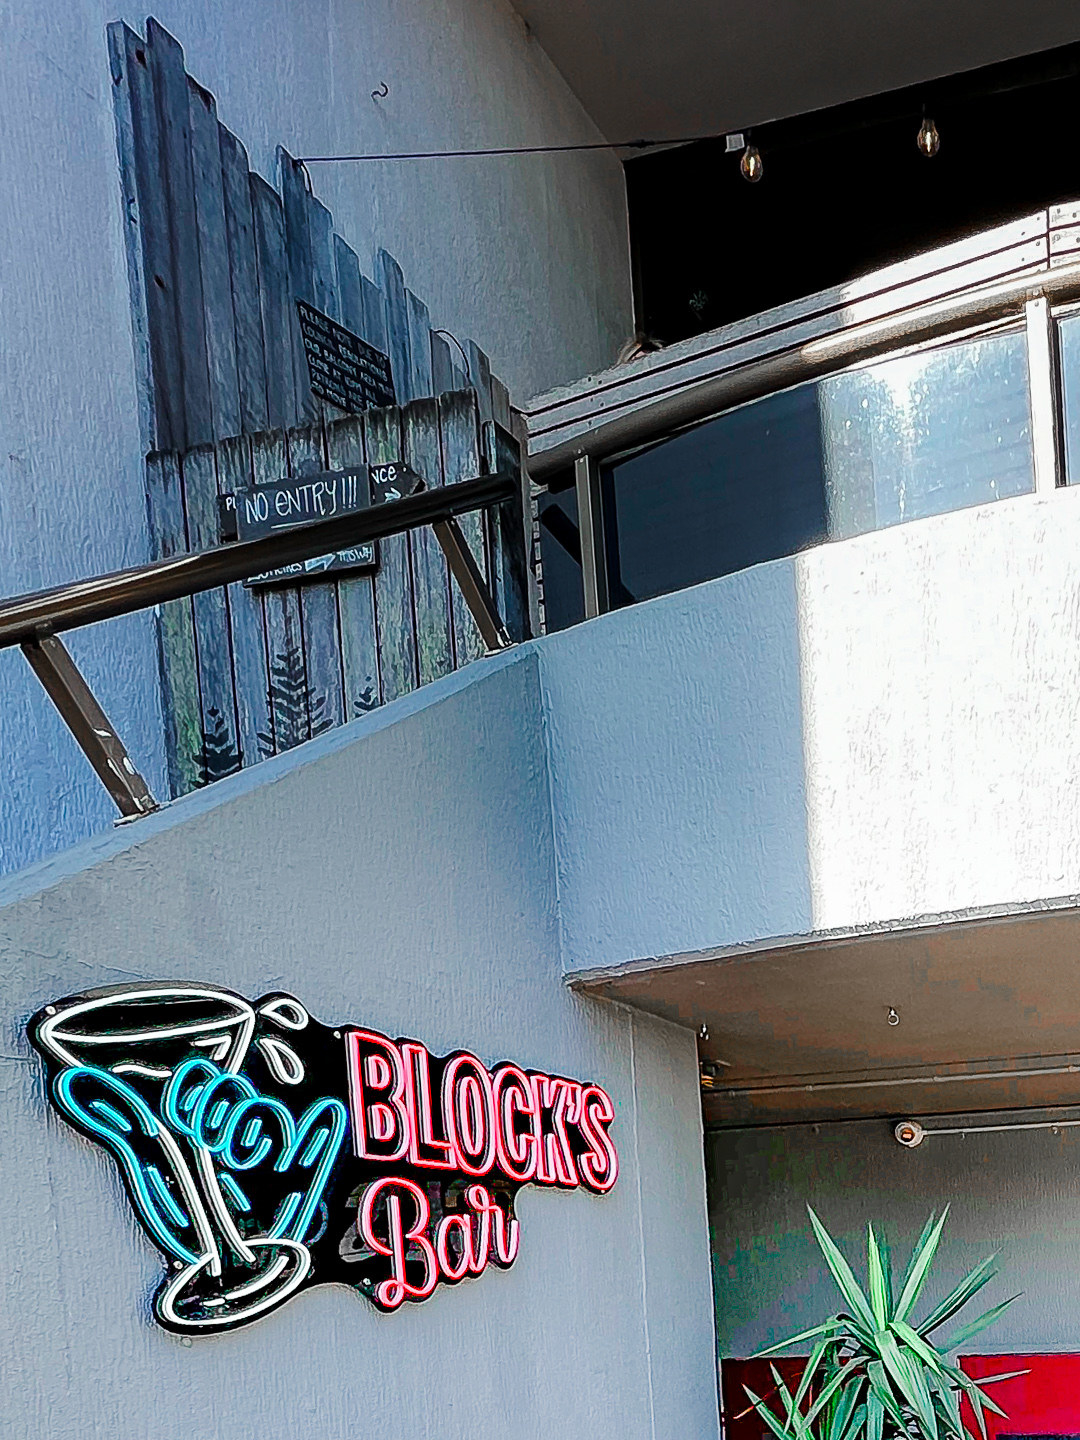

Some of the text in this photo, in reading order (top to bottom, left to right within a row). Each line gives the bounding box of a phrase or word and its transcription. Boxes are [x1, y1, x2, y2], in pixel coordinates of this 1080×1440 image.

[245, 492, 269, 524] NO
[344, 1030, 619, 1191] BLOCK'S
[358, 1177, 520, 1308] Bar
